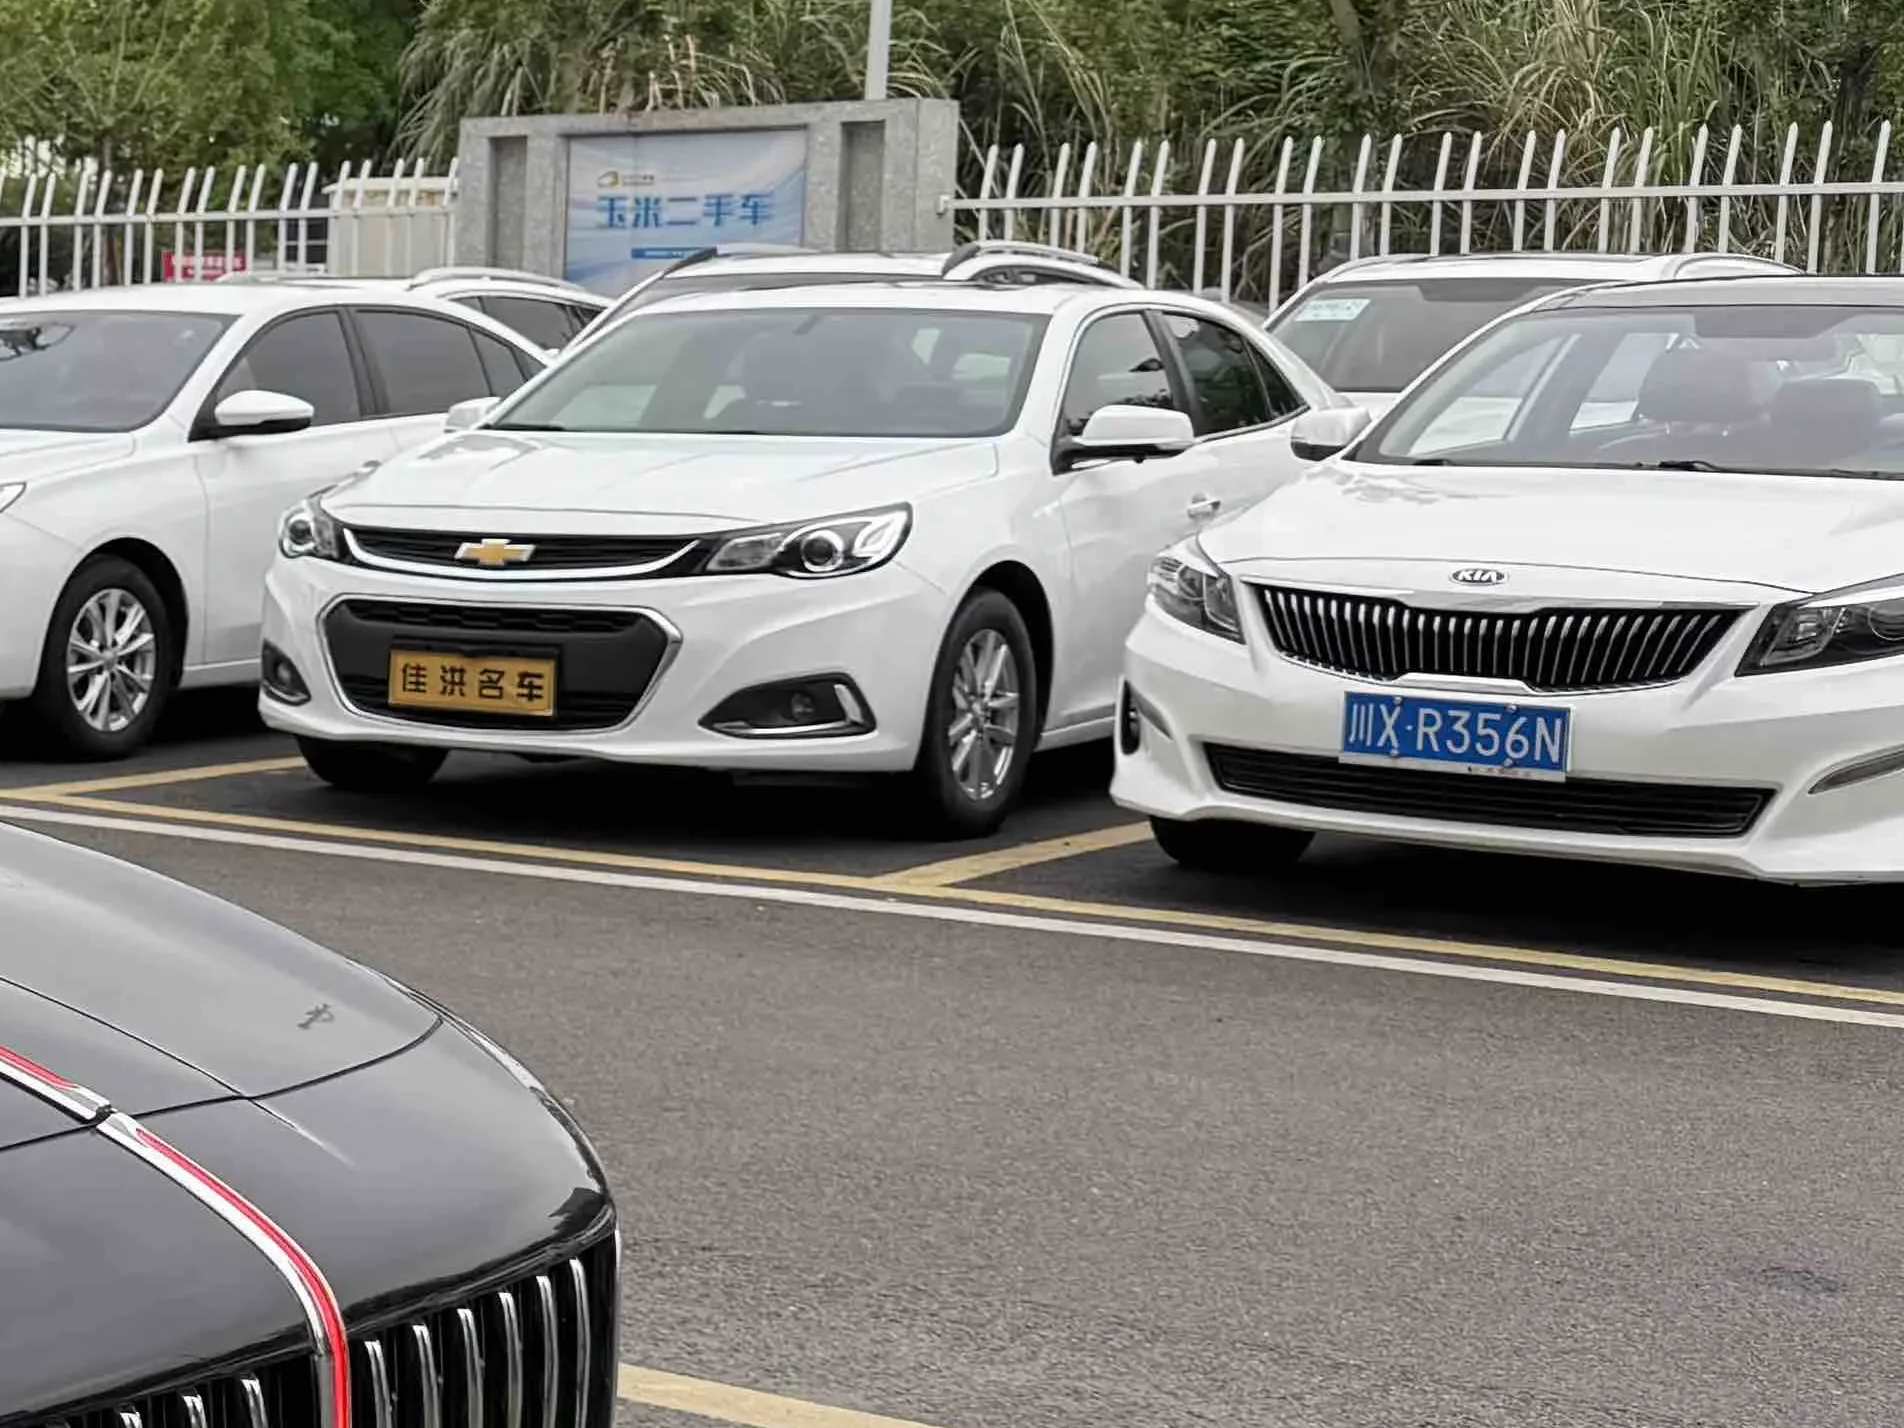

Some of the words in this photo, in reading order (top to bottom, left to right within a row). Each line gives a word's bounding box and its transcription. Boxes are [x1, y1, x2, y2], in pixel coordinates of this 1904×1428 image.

[596, 192, 775, 230] 玉米二手车
[1457, 569, 1499, 582] KIA
[400, 663, 546, 704] 佳洪名车
